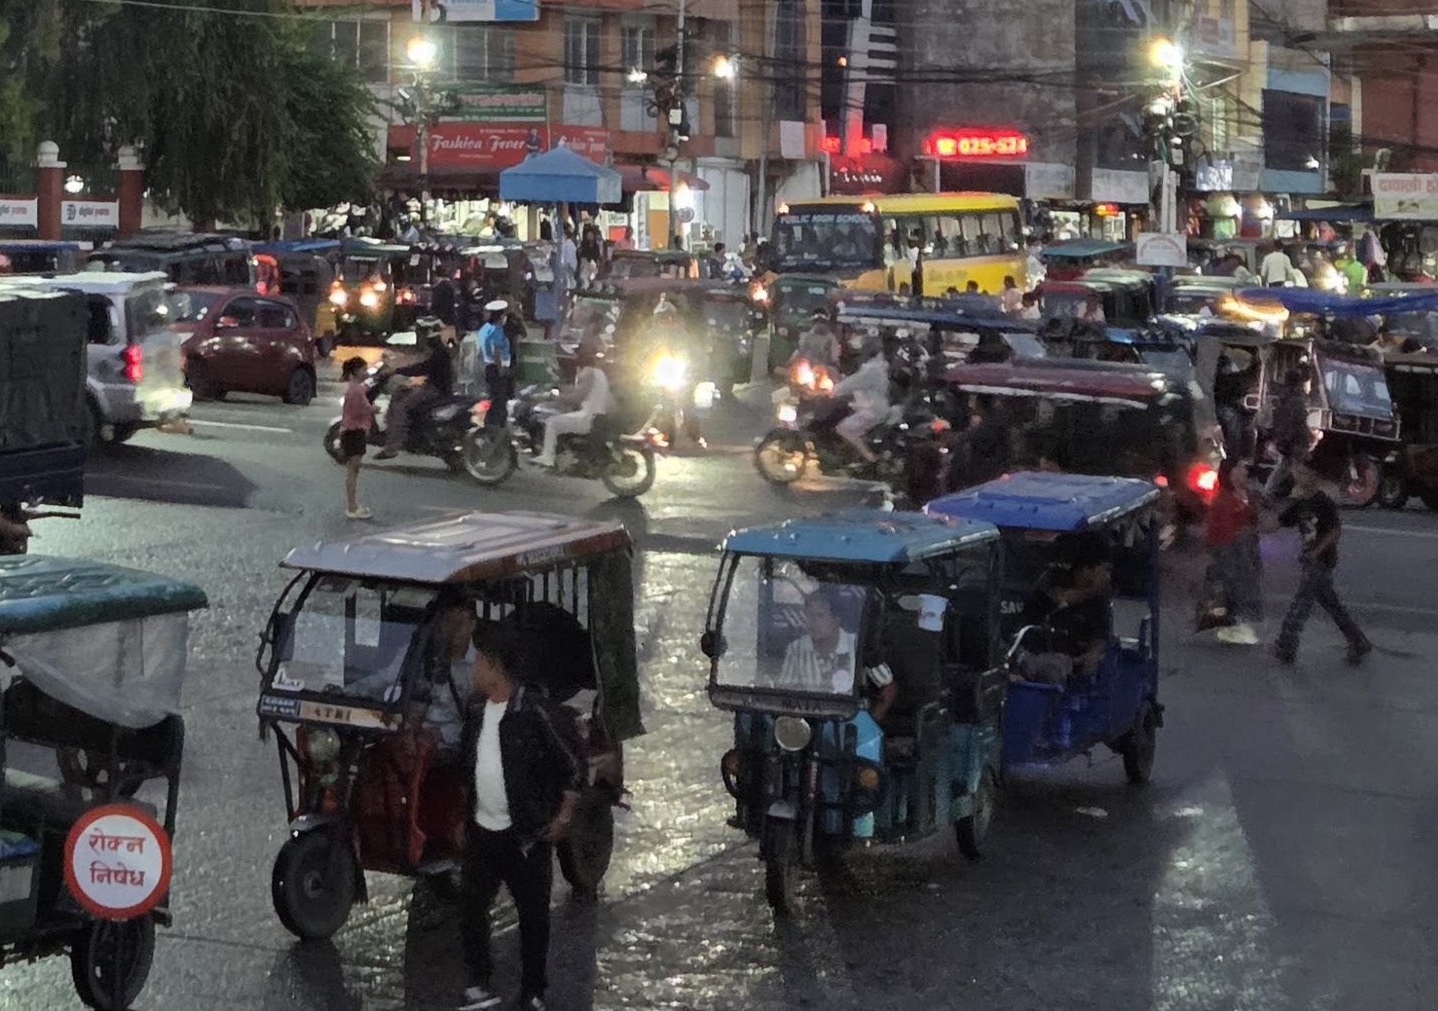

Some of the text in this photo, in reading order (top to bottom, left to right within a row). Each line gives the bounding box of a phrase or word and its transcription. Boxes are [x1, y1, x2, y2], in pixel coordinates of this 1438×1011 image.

[430, 135, 482, 151] Fashion
[780, 214, 810, 225] PUBLIC
[836, 213, 872, 224] SCHOOL
[89, 860, 146, 887] निषेध
